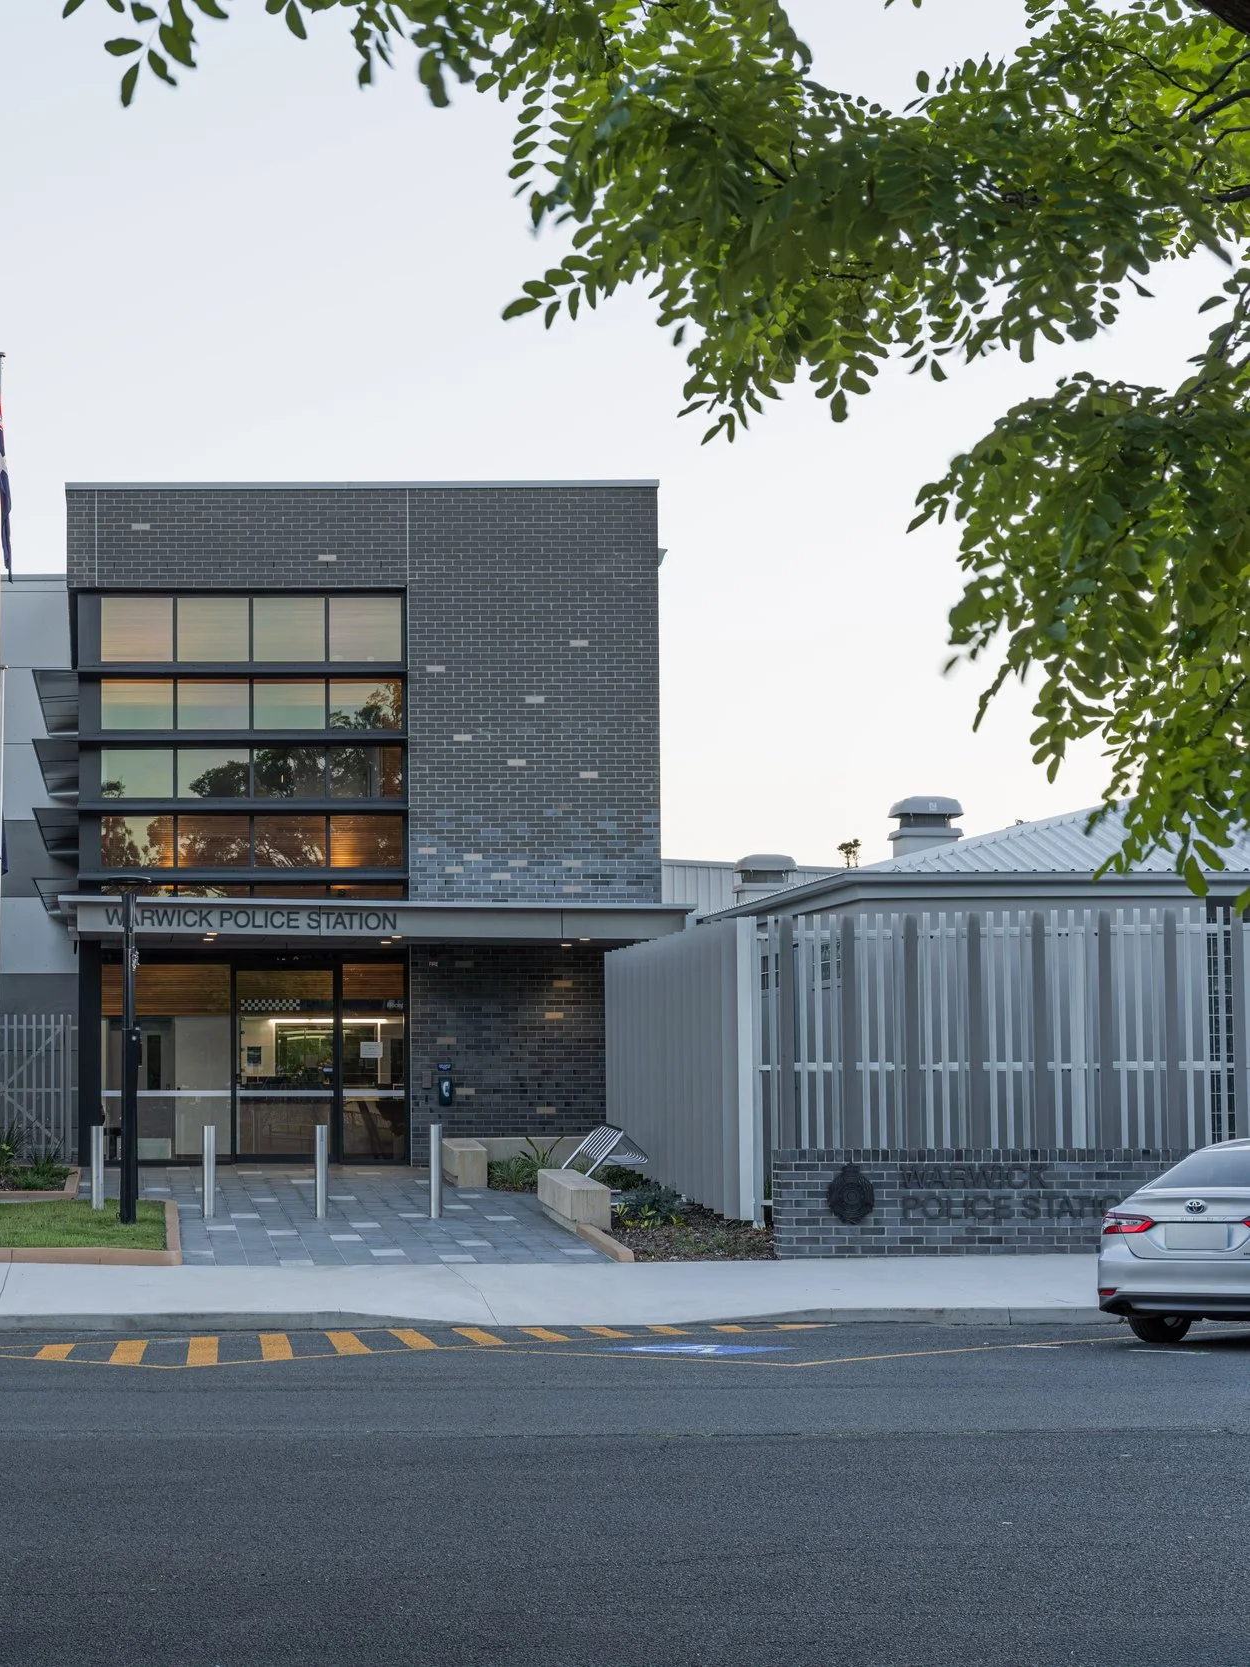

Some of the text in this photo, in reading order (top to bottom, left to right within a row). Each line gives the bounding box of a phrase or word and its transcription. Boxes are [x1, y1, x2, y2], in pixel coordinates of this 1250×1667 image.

[220, 910, 300, 929] POLICE
[307, 911, 397, 931] STATION
[901, 1164, 1050, 1190] WARWICK
[902, 1194, 1130, 1220] POLICE STATIO
